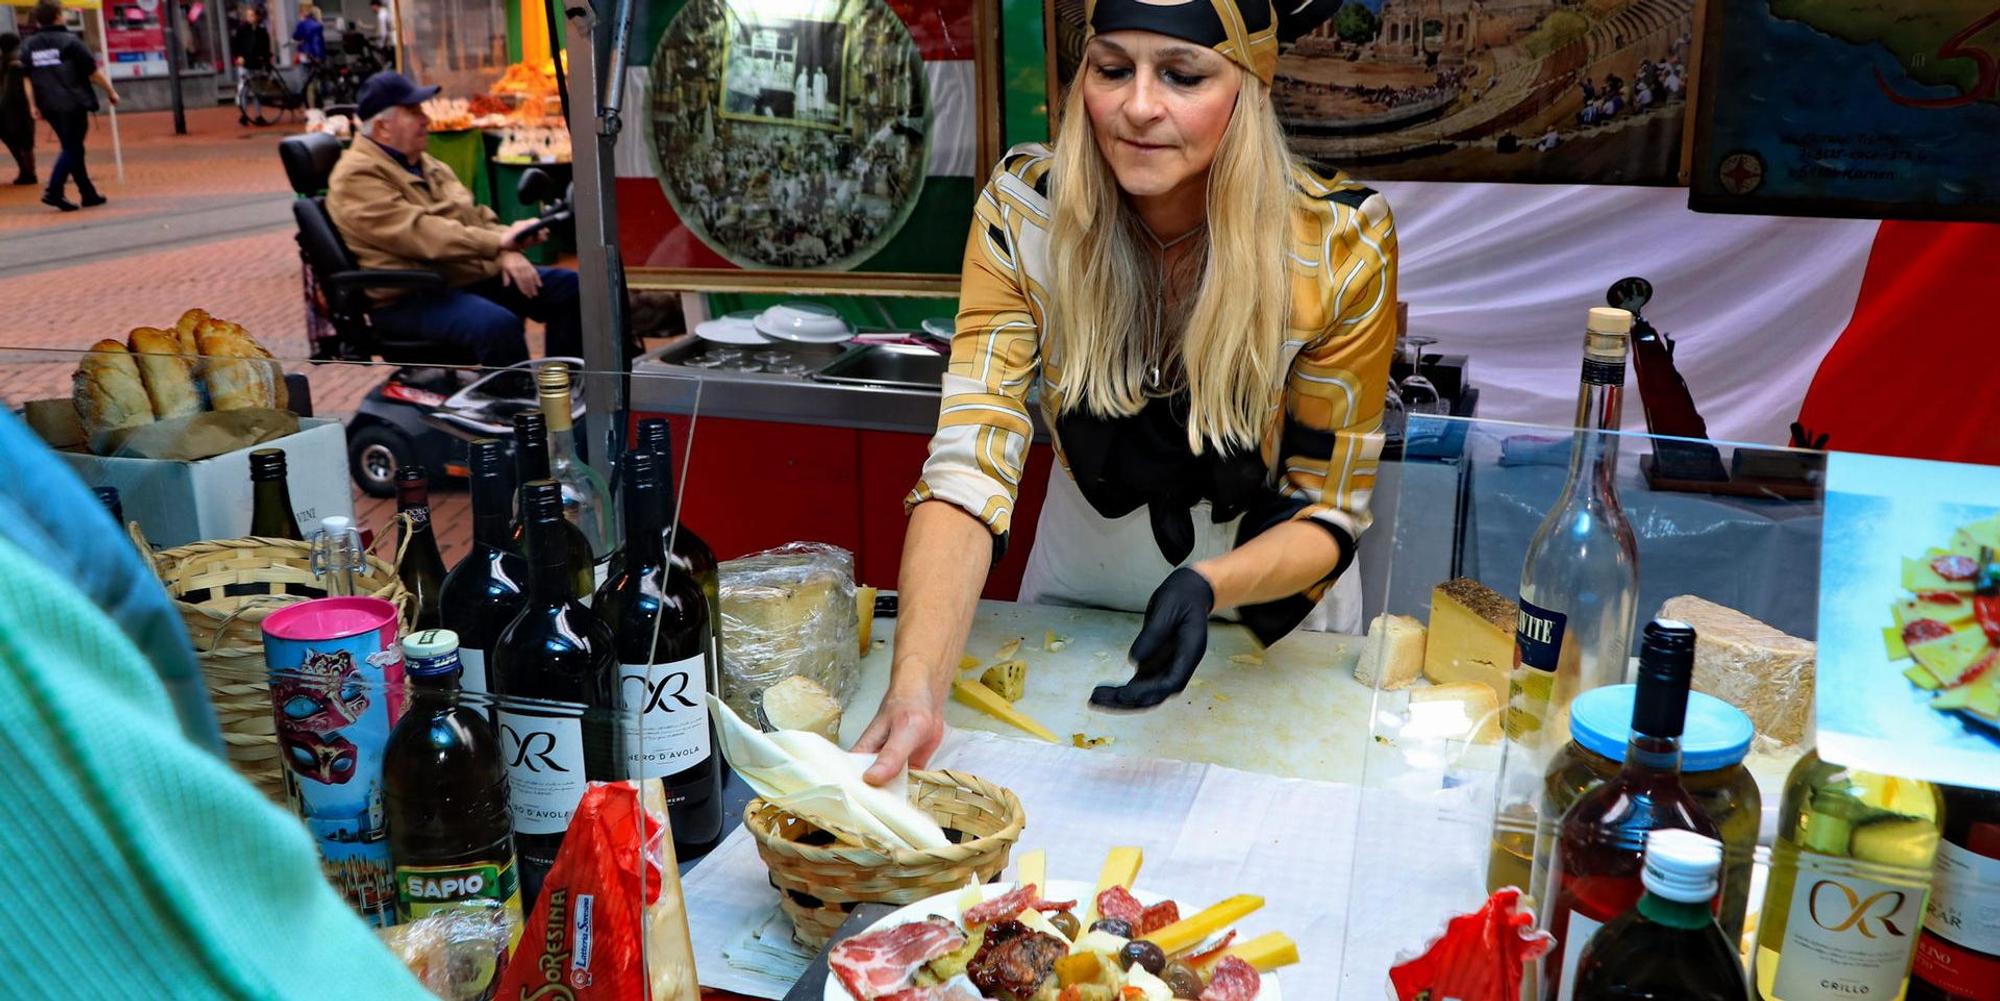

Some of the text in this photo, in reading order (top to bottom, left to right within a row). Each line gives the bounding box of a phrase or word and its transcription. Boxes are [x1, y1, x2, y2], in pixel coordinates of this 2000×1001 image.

[659, 745, 700, 760] D'AVOLA
[406, 873, 484, 899] SAPIO
[1809, 879, 1906, 939] OR
